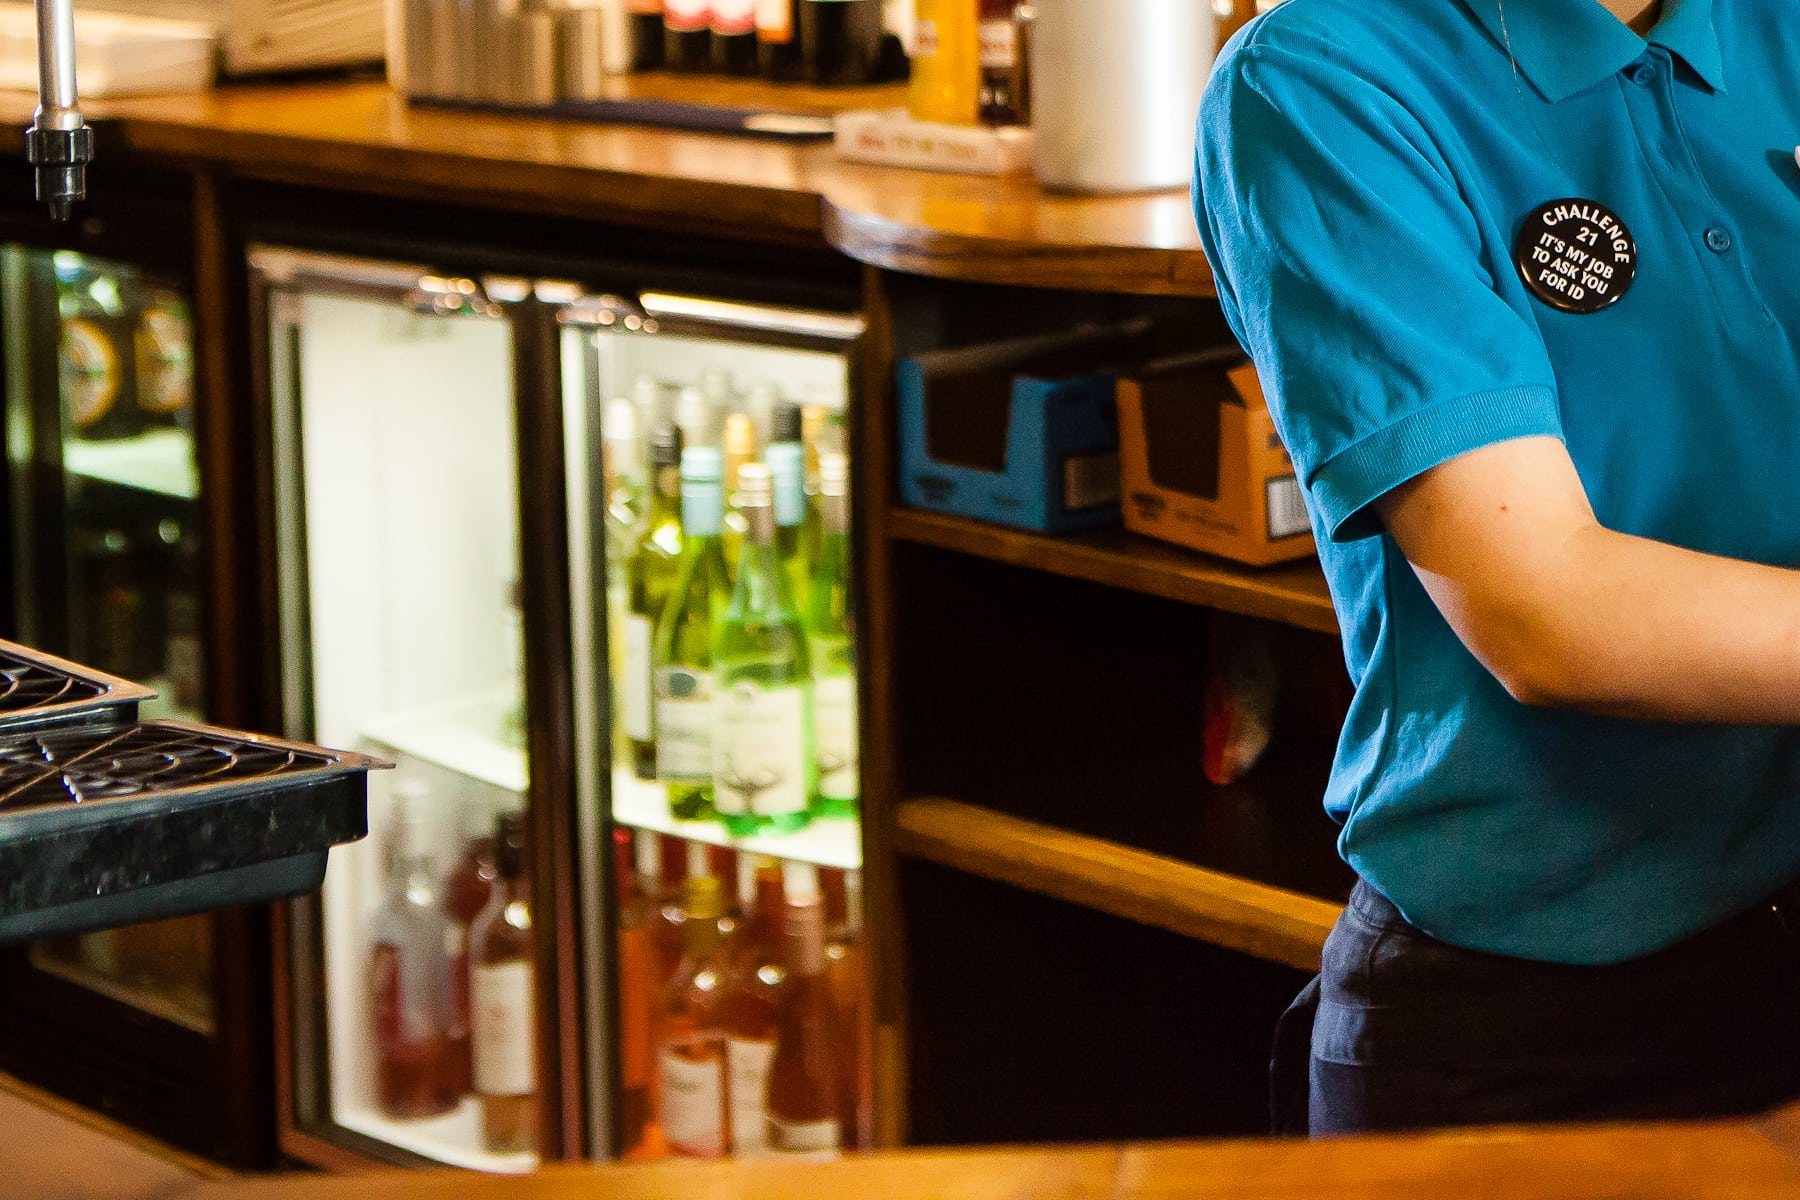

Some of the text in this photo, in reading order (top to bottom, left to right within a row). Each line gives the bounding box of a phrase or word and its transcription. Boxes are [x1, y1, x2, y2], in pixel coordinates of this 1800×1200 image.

[1539, 232, 1614, 279] IT'S MY JOB
[1542, 204, 1630, 264] CHALLENGE
[1576, 227, 1598, 246] 21
[1531, 246, 1609, 295] TO ASK YOU
[1539, 269, 1584, 300] FOR ID
